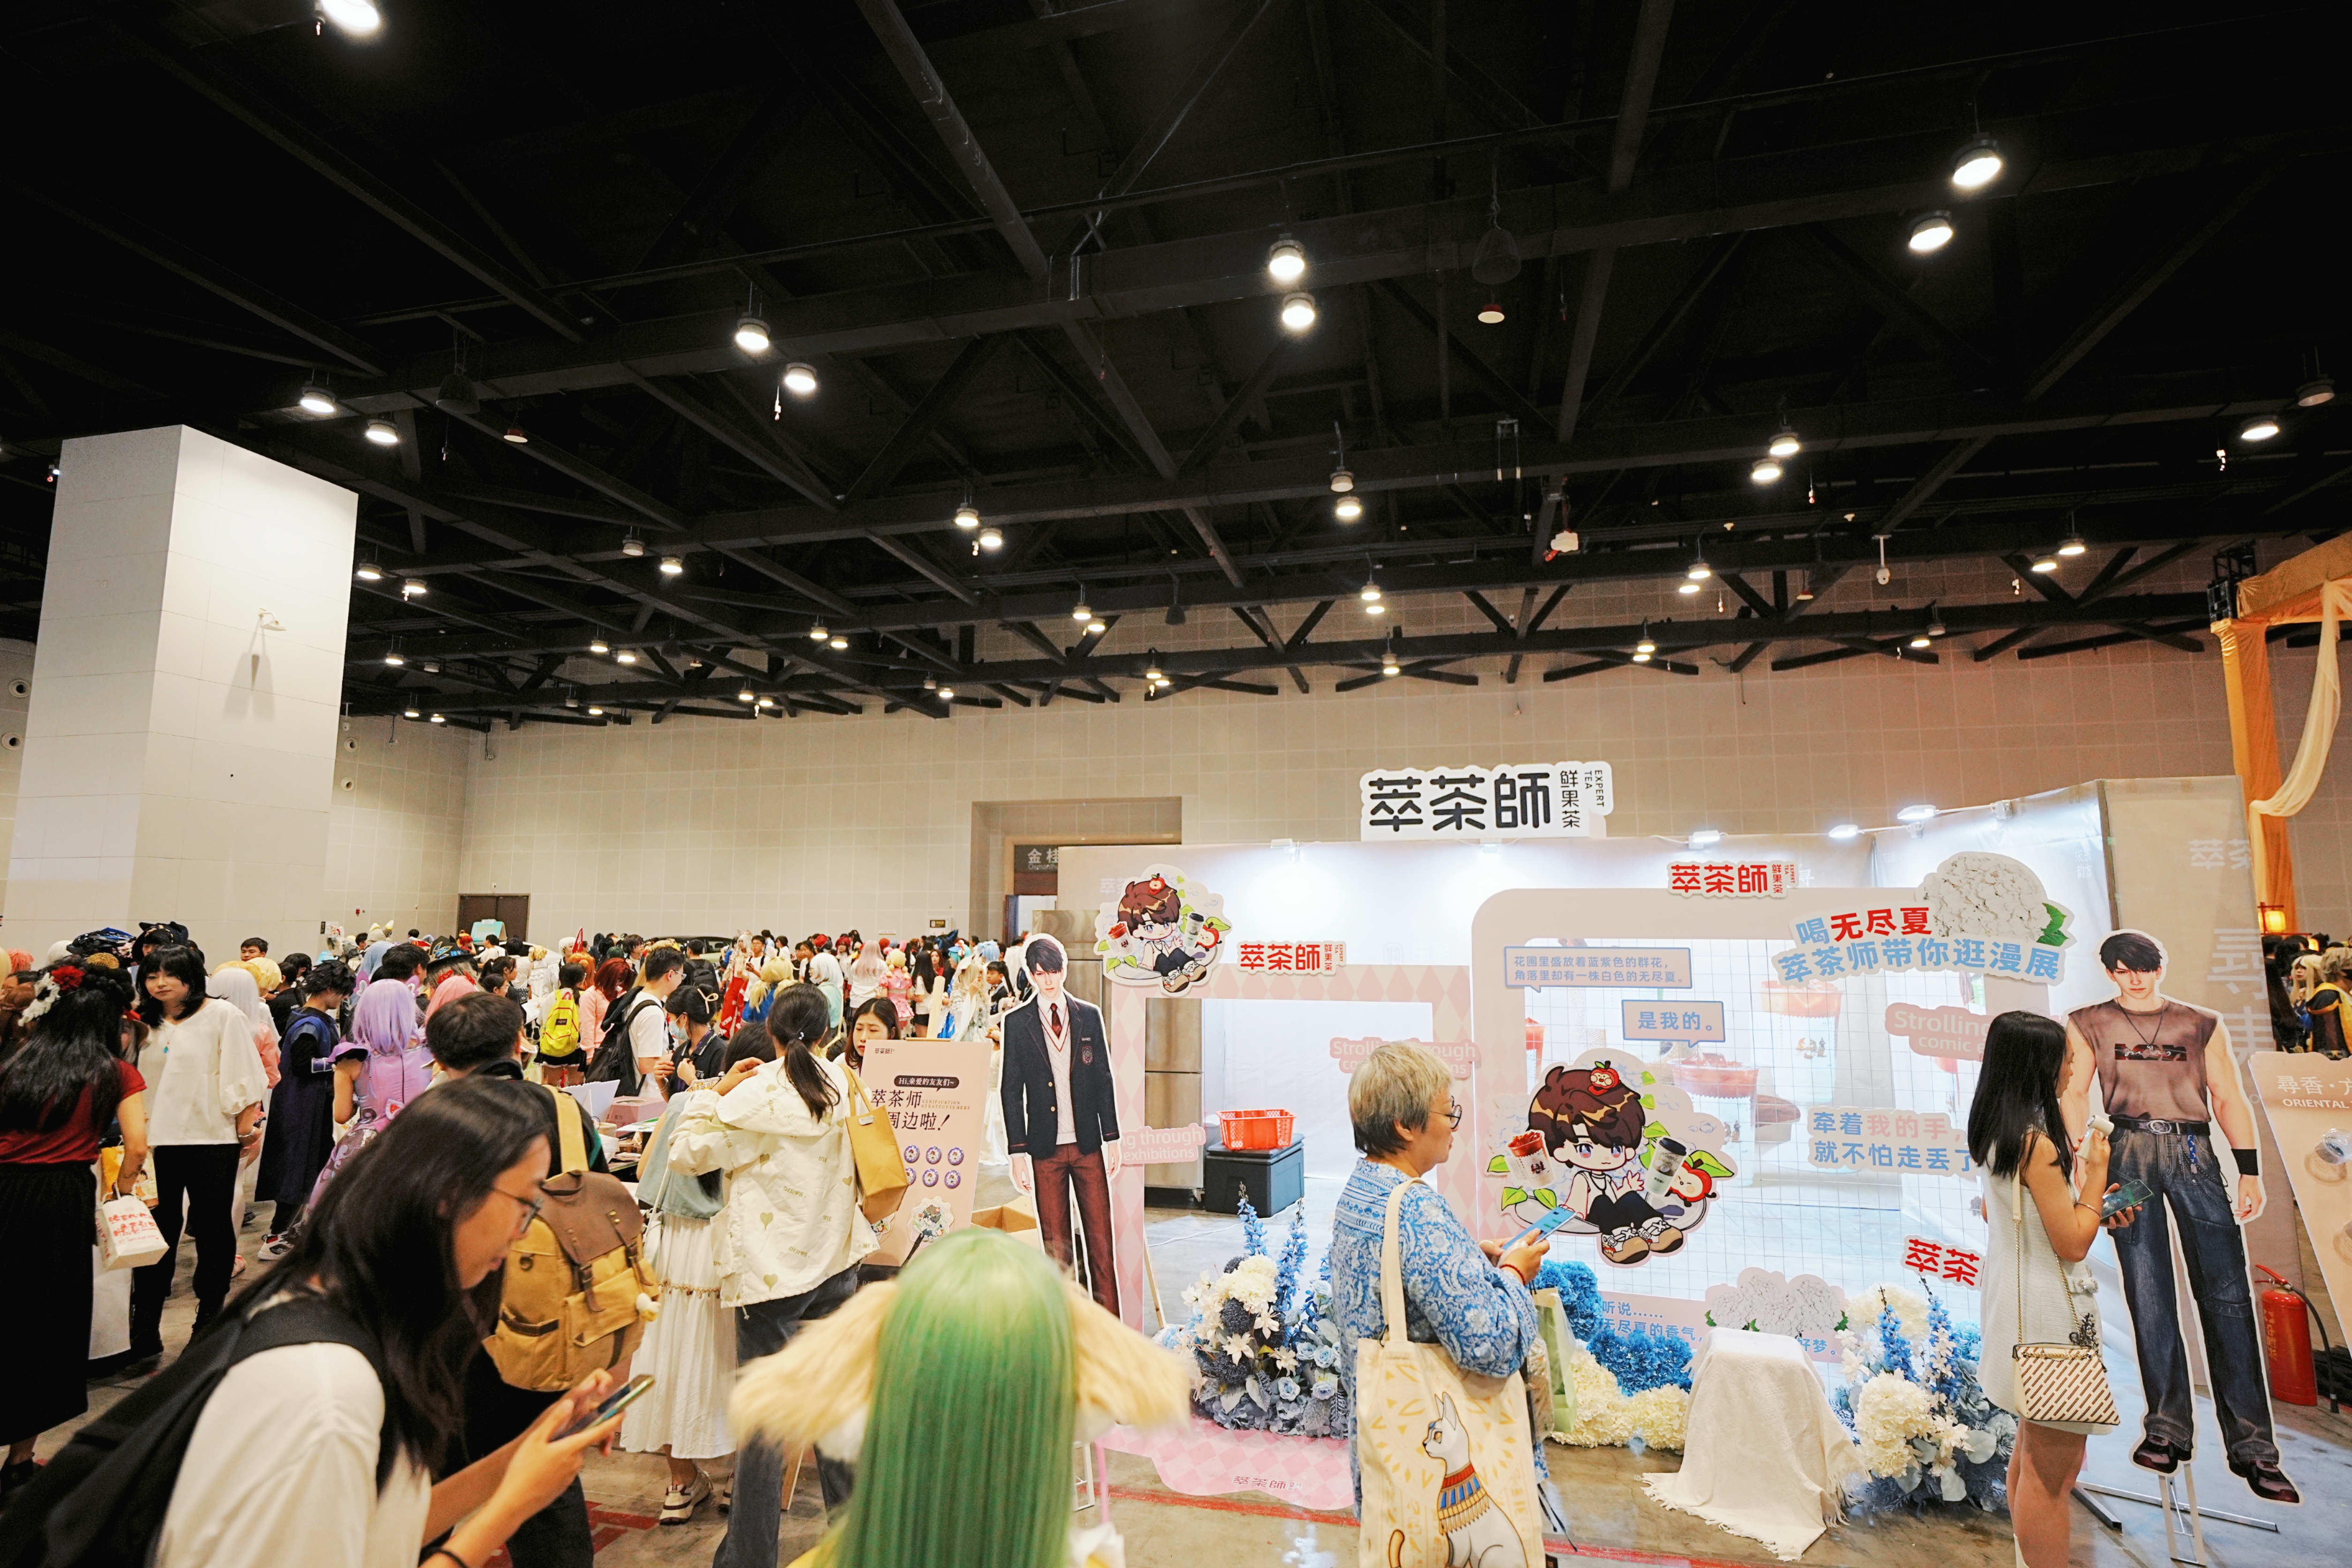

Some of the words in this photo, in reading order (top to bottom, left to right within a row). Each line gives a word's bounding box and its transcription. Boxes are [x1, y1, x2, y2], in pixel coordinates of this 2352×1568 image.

[1584, 770, 1593, 790] TEA
[1595, 769, 1604, 807] EXPERT
[1369, 773, 1551, 832] 萃茶師
[1027, 848, 1059, 863] 金桂
[1671, 864, 1768, 893] 萃茶師
[1796, 907, 1932, 944] 喝无尽夏
[1241, 944, 1320, 970] 萃茶師
[1778, 938, 2059, 982] 萃茶师带你逛漫展
[1515, 970, 1683, 983] 角落里却有一株白色的无尽夏。
[1638, 1011, 1713, 1031] 是我的。
[1919, 1037, 1971, 1053] comic
[871, 1089, 922, 1108] 萃茶师
[2283, 1099, 2350, 1108] ORIENTAL
[1139, 1127, 1202, 1146] through
[1123, 1147, 1195, 1161] exhibitions
[1814, 1140, 1972, 1172] 就不怕走丢了
[1905, 1239, 1985, 1287] 萃茶
[1232, 1476, 1287, 1489] 萃茶師
